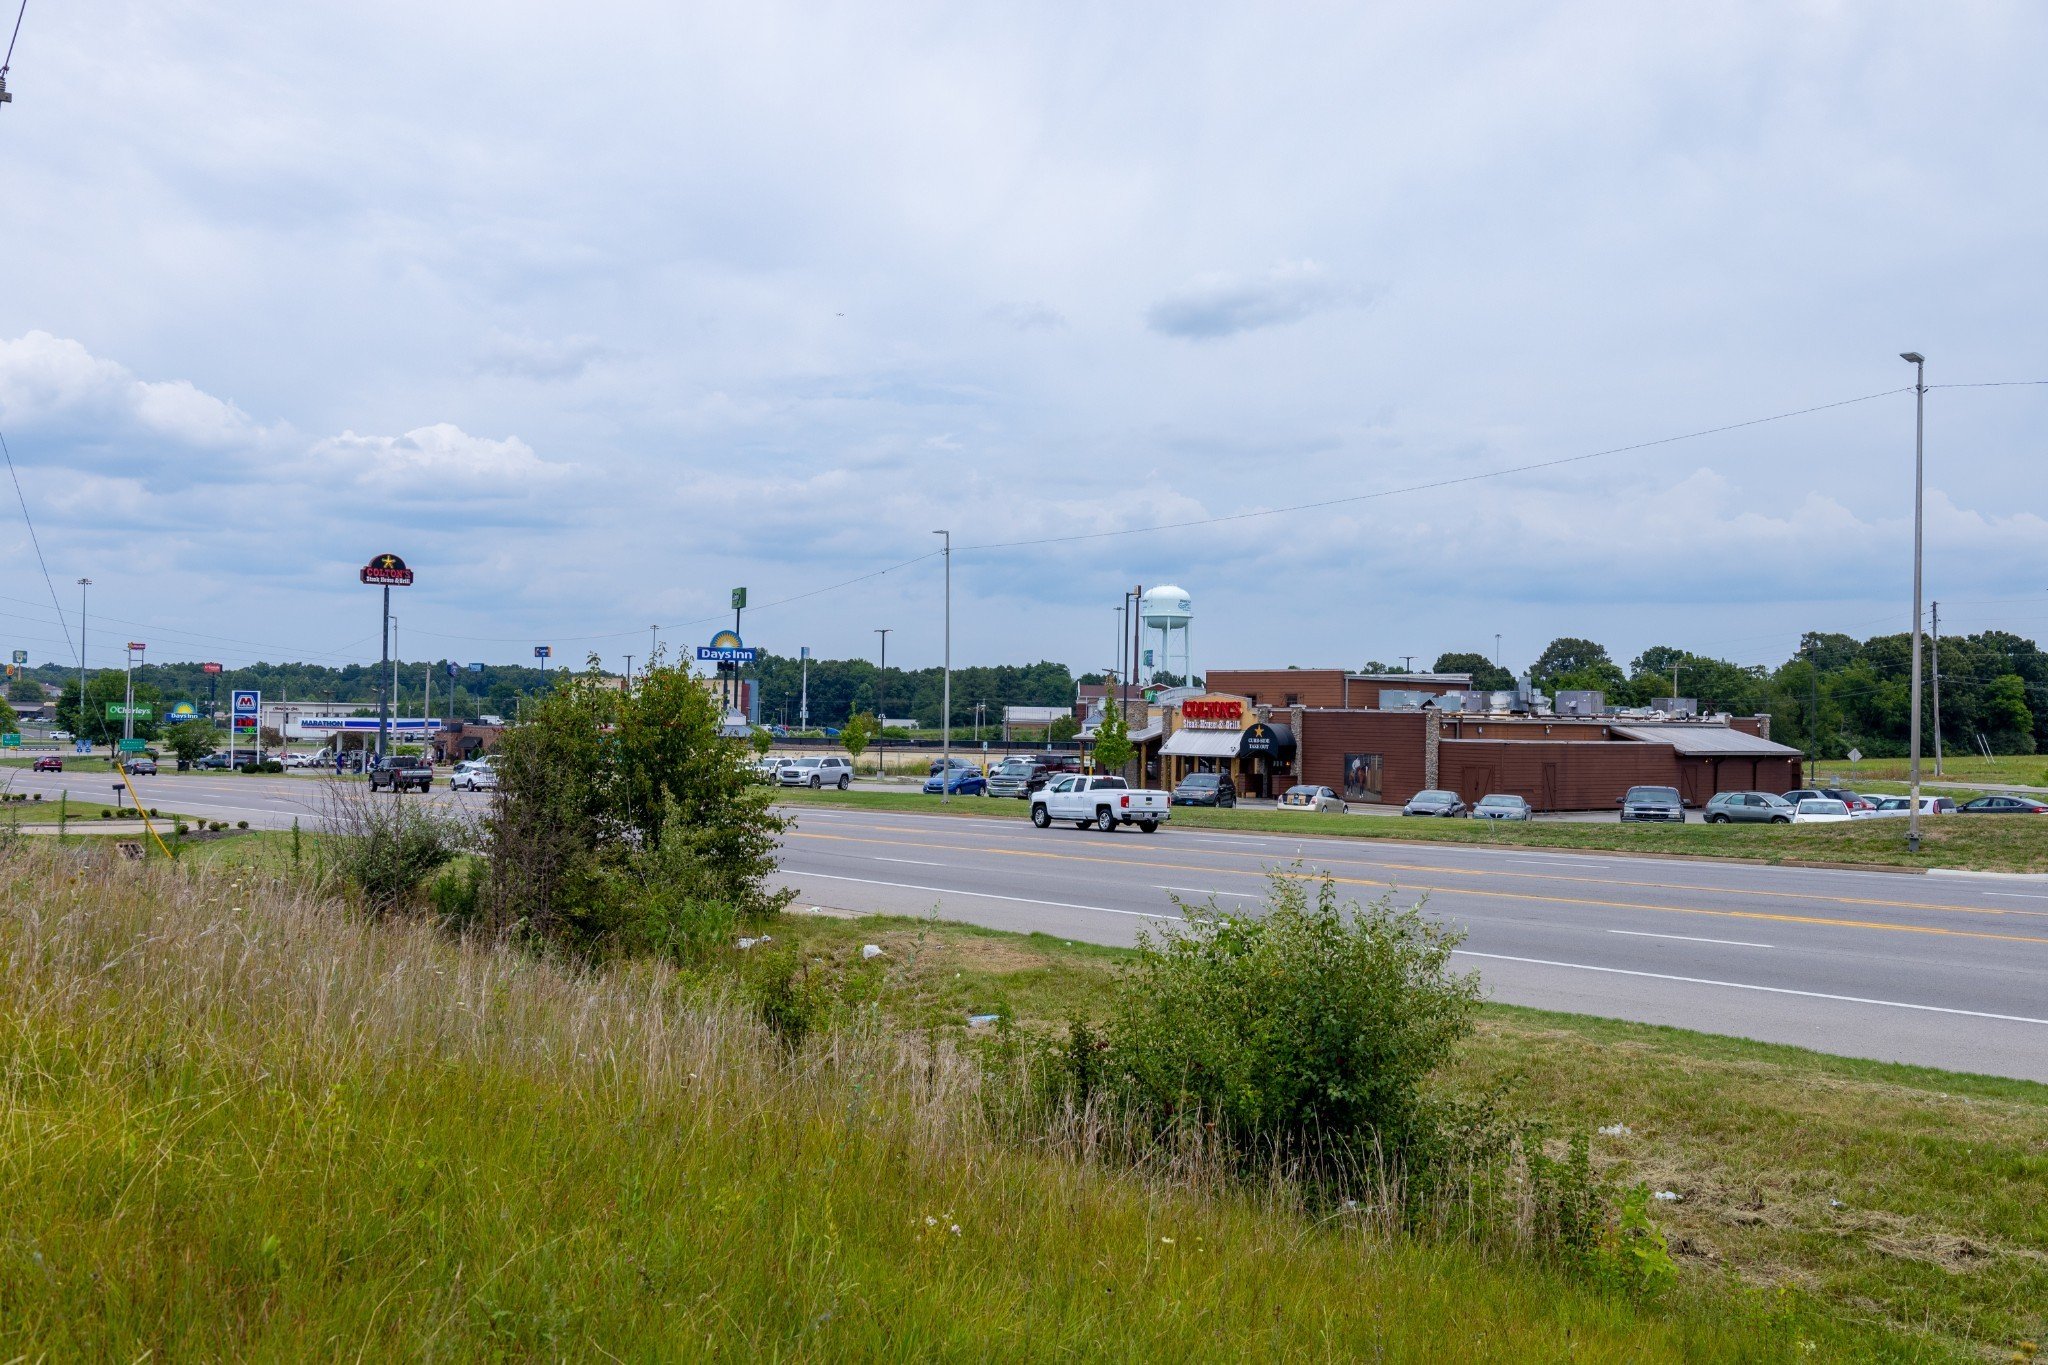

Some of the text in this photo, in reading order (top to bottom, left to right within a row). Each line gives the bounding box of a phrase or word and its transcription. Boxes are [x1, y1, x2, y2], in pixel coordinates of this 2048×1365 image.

[366, 568, 410, 578] COLTON'S
[701, 649, 753, 660] Days Inn
[1182, 701, 1241, 718] COLTON'S
[1183, 719, 1241, 729] Steak House & Grill
